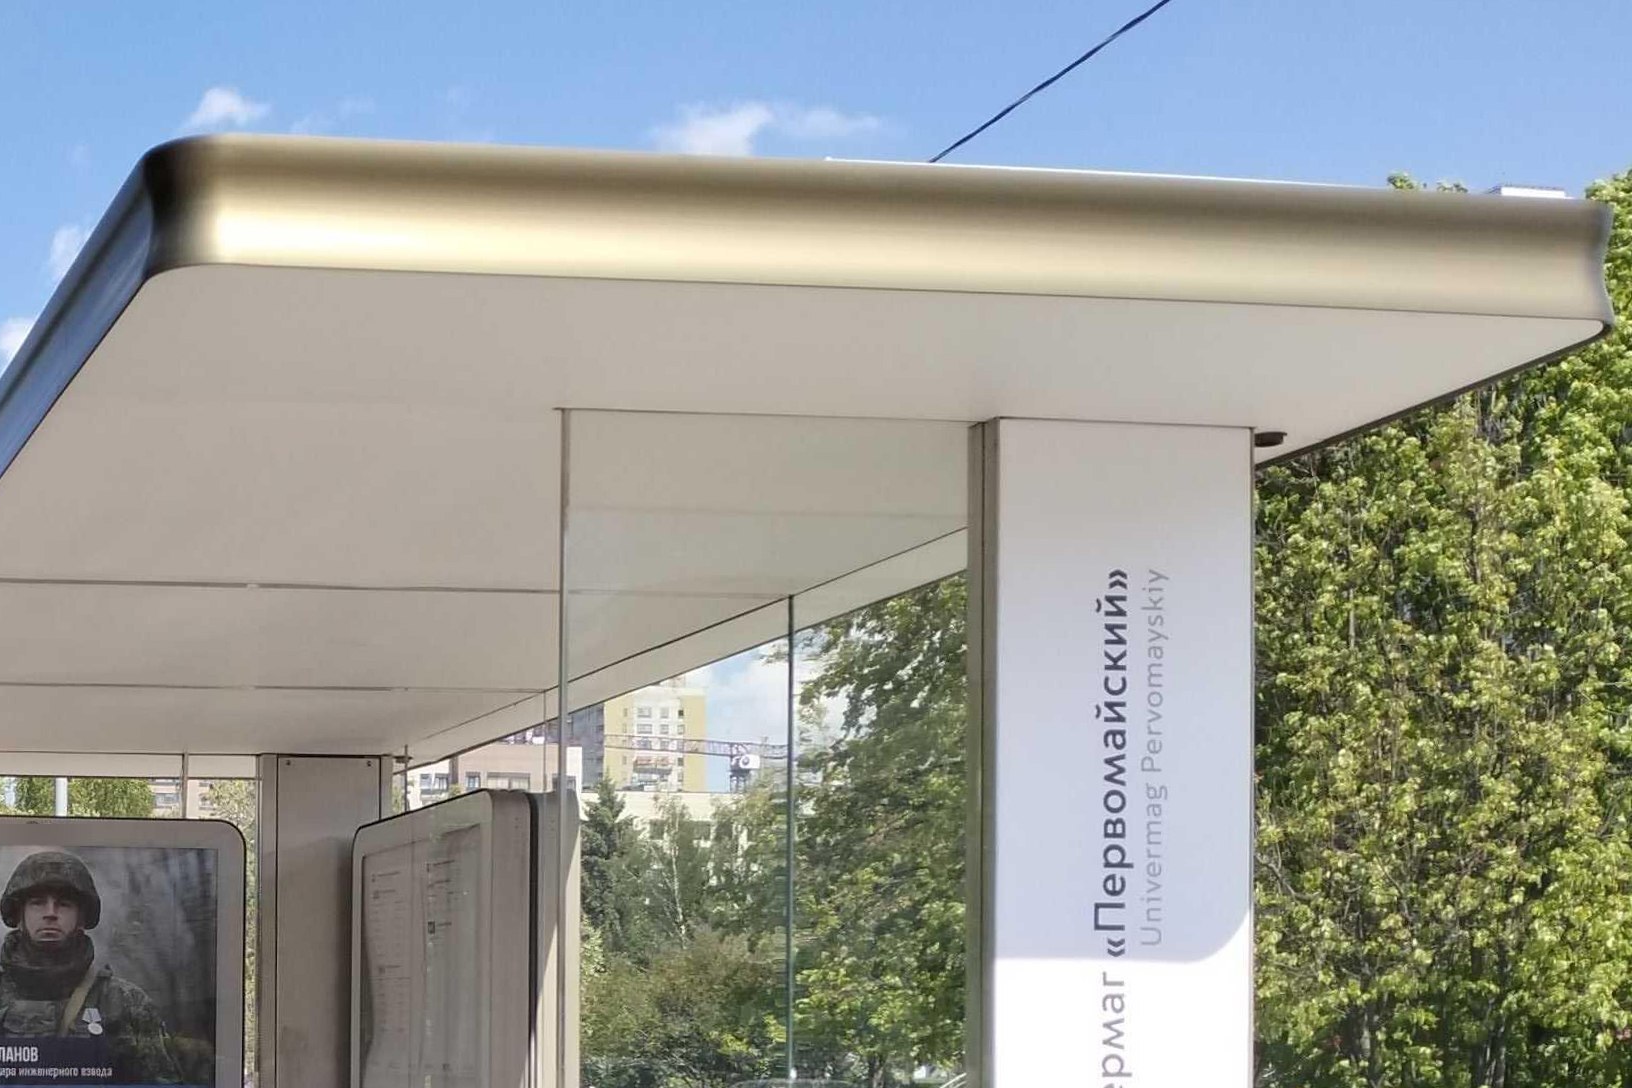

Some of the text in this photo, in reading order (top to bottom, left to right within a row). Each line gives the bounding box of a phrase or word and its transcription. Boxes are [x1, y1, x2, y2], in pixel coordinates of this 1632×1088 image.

[1094, 569, 1134, 958] «Первомайский»
[1141, 568, 1169, 946] Univermag Pervomayskiy
[19, 1067, 79, 1078] инженерного
[81, 1067, 113, 1077] взвода
